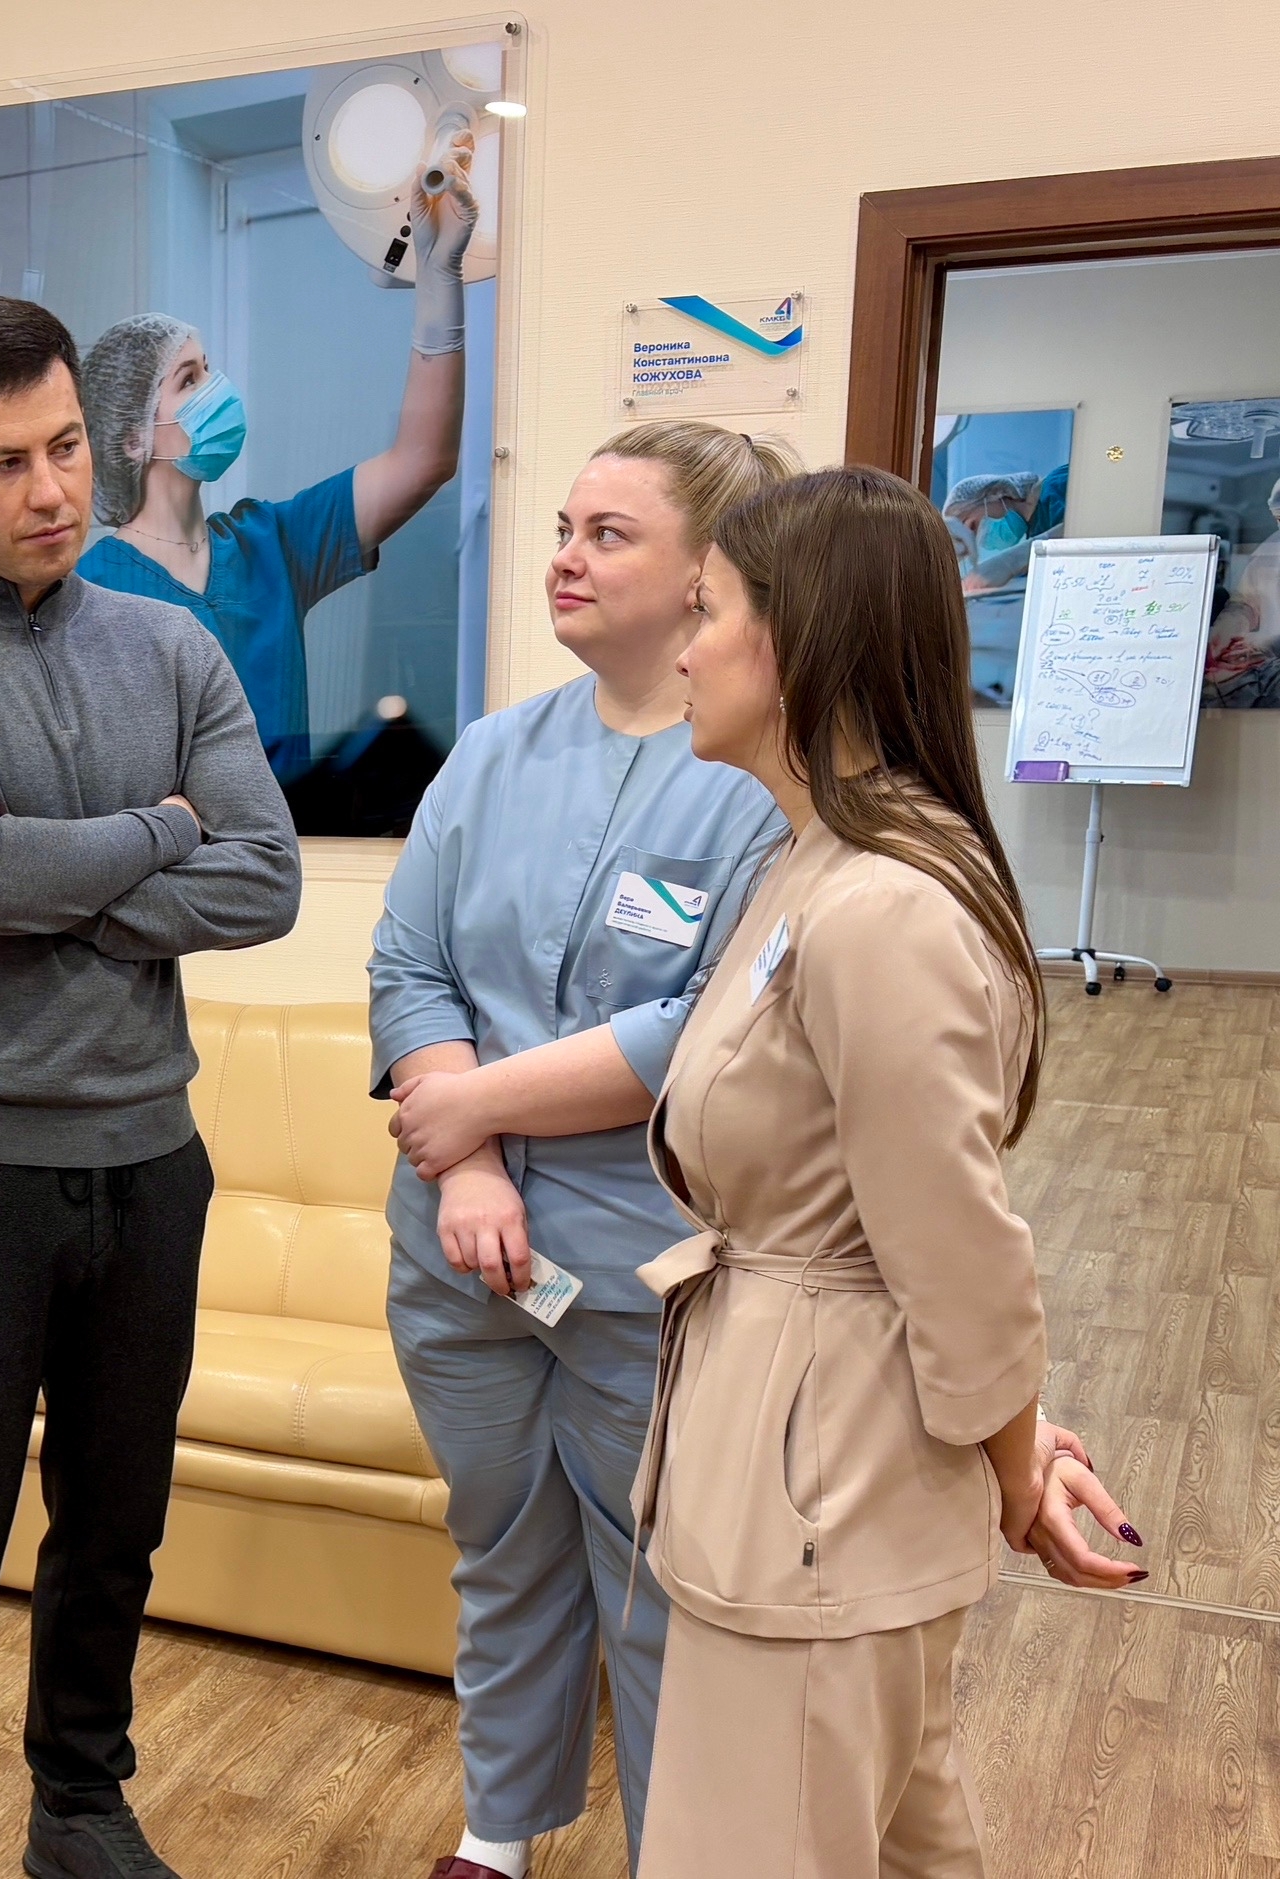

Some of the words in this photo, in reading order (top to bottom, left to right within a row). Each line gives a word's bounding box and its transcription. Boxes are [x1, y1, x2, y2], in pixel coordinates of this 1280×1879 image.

[633, 341, 691, 354] Вероника
[633, 354, 730, 368] Константиновна
[632, 369, 703, 383] КОЖУХОВА
